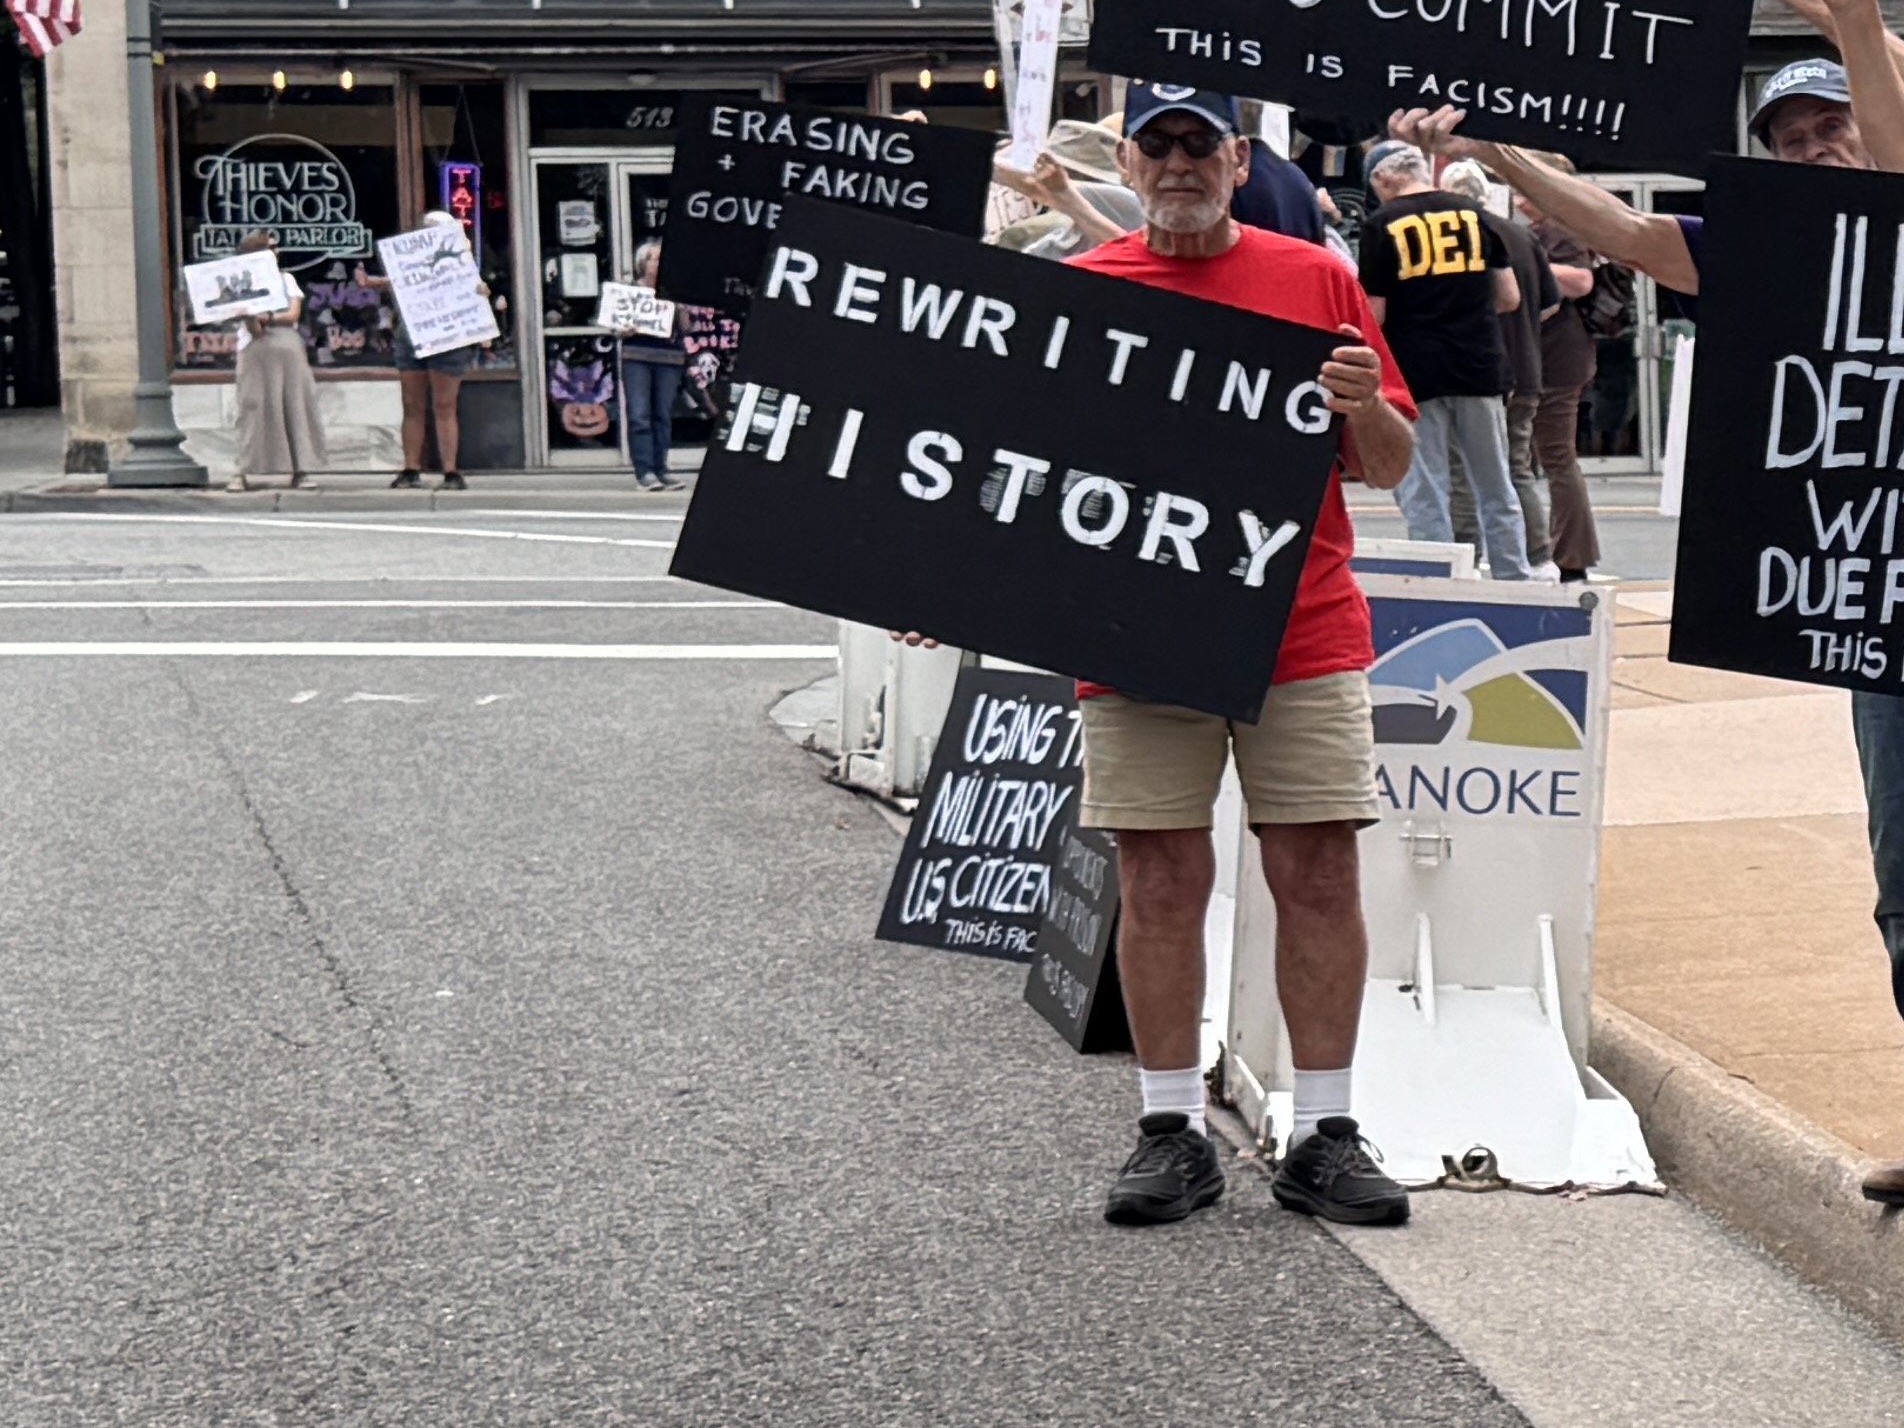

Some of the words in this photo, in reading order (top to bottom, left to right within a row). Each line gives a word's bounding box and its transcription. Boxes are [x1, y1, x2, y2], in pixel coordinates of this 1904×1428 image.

[1307, 53, 1344, 78] IS
[1388, 65, 1626, 141] FACISM!!!!
[710, 106, 914, 165] ERASING
[194, 155, 340, 196] THIEVES
[782, 162, 929, 210] FAKING
[217, 192, 354, 223] HONOR
[687, 191, 783, 229] GOVE
[207, 227, 280, 247] TATO
[286, 227, 360, 246] PARLOR
[1386, 209, 1487, 280] DEI
[765, 246, 1335, 435] REWRITING
[726, 383, 1299, 588] HISTORY
[1756, 546, 1871, 621] DUE
[1375, 764, 1581, 817] ANOKE
[1003, 924, 1038, 953] FAC
